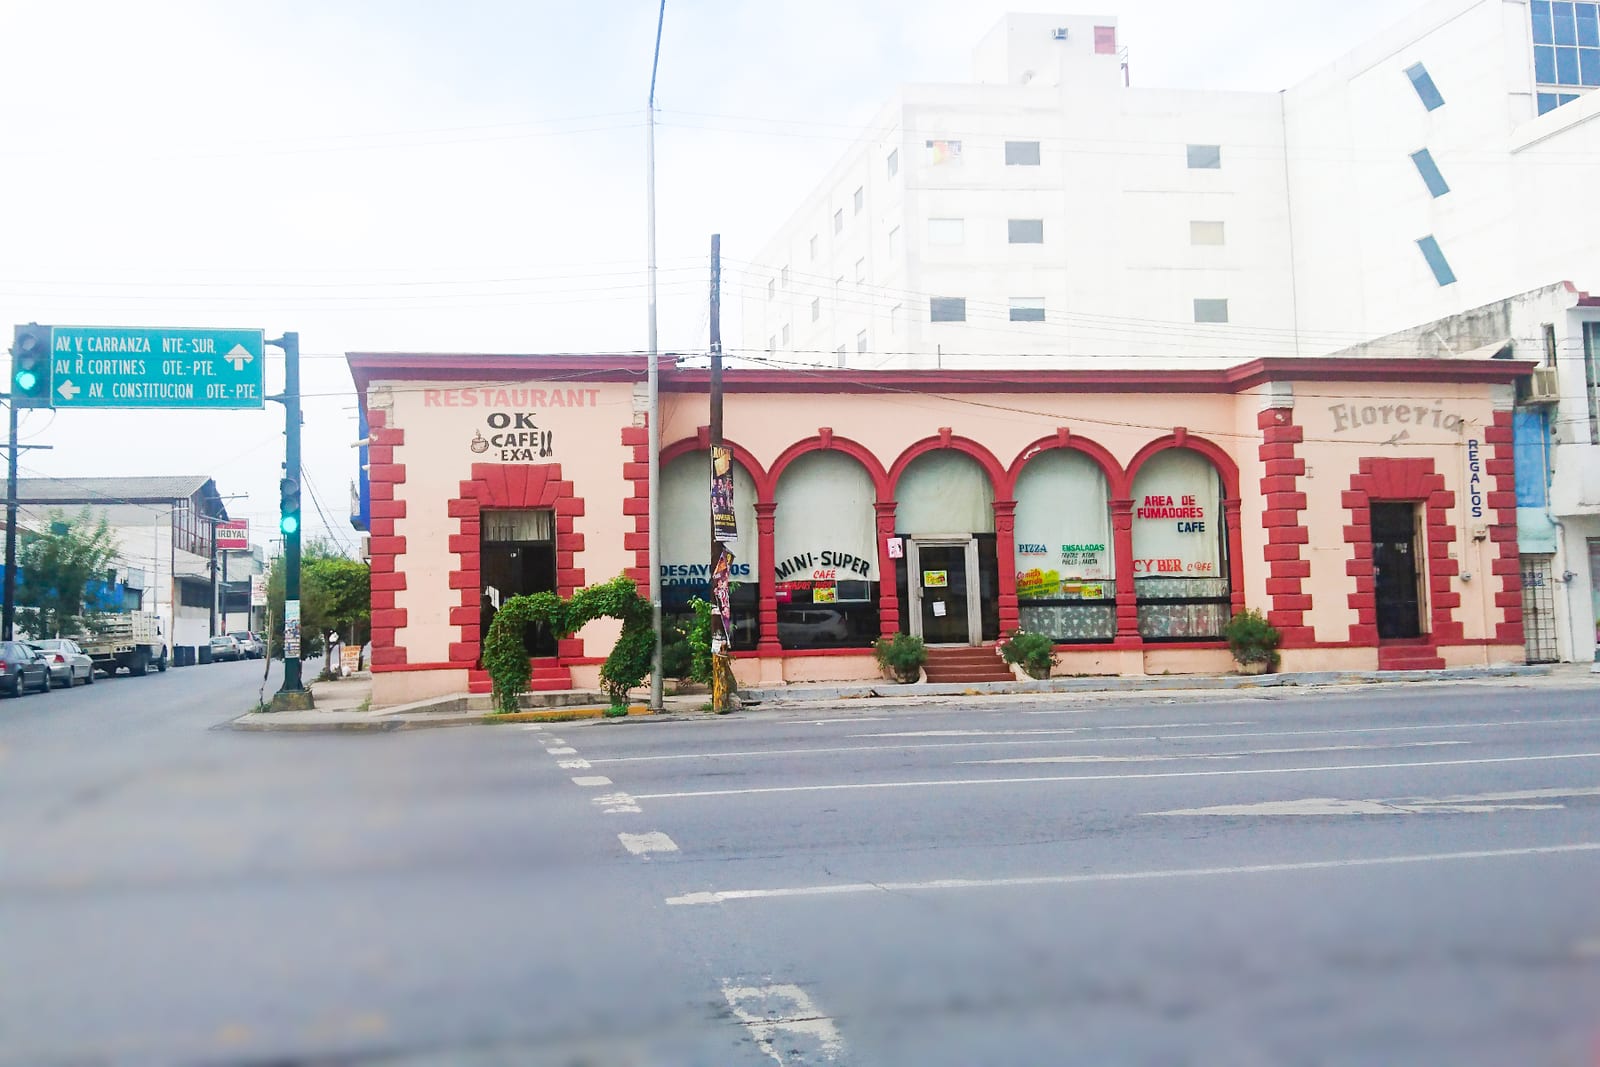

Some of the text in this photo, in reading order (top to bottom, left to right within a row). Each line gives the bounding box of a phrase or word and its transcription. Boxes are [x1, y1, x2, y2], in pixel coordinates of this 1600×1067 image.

[56, 336, 71, 352] AV.
[75, 336, 83, 352] V.
[88, 337, 151, 352] CARRANZA
[55, 360, 71, 374] AV.
[88, 360, 146, 375] CORTINES
[88, 383, 104, 398] AV.
[112, 383, 193, 399] CONSTITUCION
[424, 389, 601, 408] RESTAURANT
[487, 412, 539, 429] OK
[491, 432, 539, 447] CAFE
[1468, 439, 1482, 518] REGALOS
[1144, 495, 1196, 506] AREA DE
[1137, 508, 1204, 519] FUMADORES
[1177, 522, 1206, 532] CAFE
[1018, 543, 1047, 552] PIZZA
[660, 564, 750, 577] DESAYOS
[775, 551, 870, 579] MINI-SUPER
